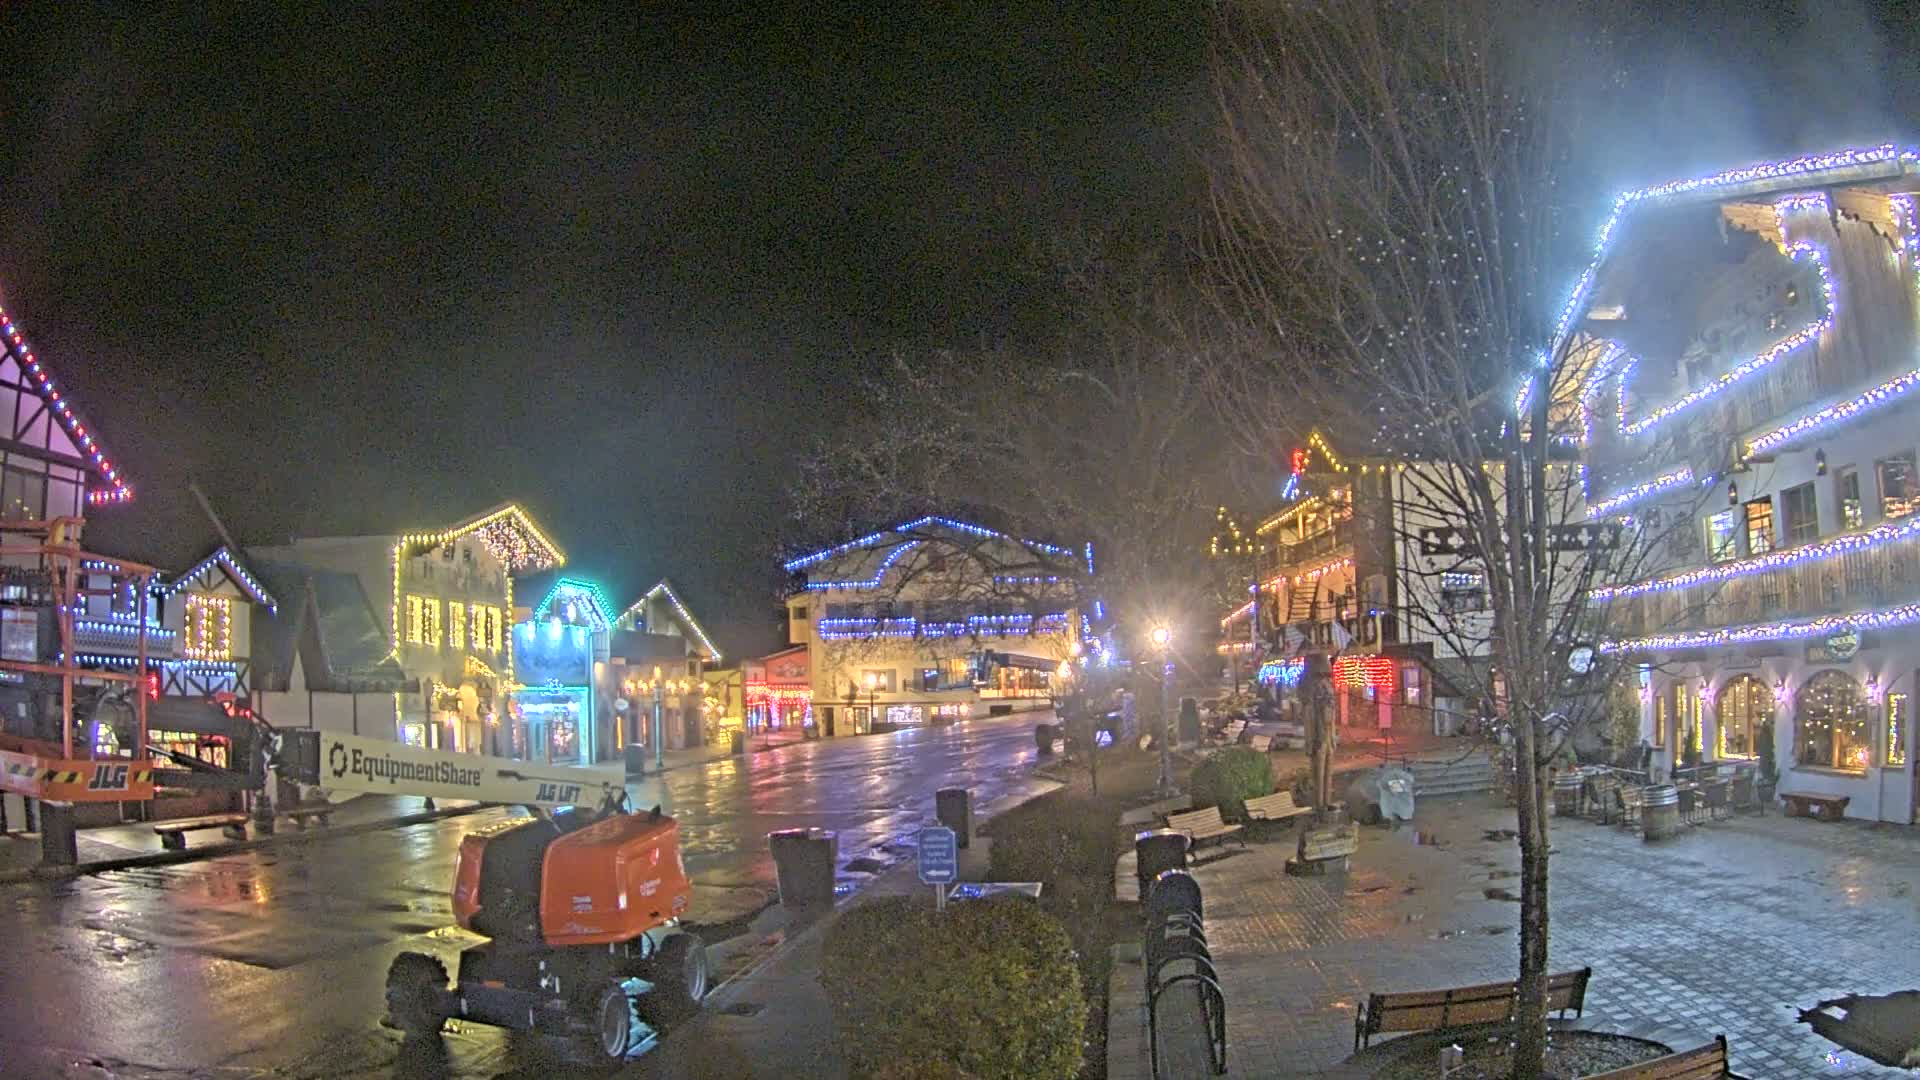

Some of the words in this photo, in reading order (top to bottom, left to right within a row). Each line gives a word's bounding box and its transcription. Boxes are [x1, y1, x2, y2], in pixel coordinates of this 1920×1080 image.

[88, 763, 129, 791] JLG
[351, 748, 481, 786] EquipmentShare
[535, 783, 556, 801] JLG
[559, 784, 580, 802] LIFT
